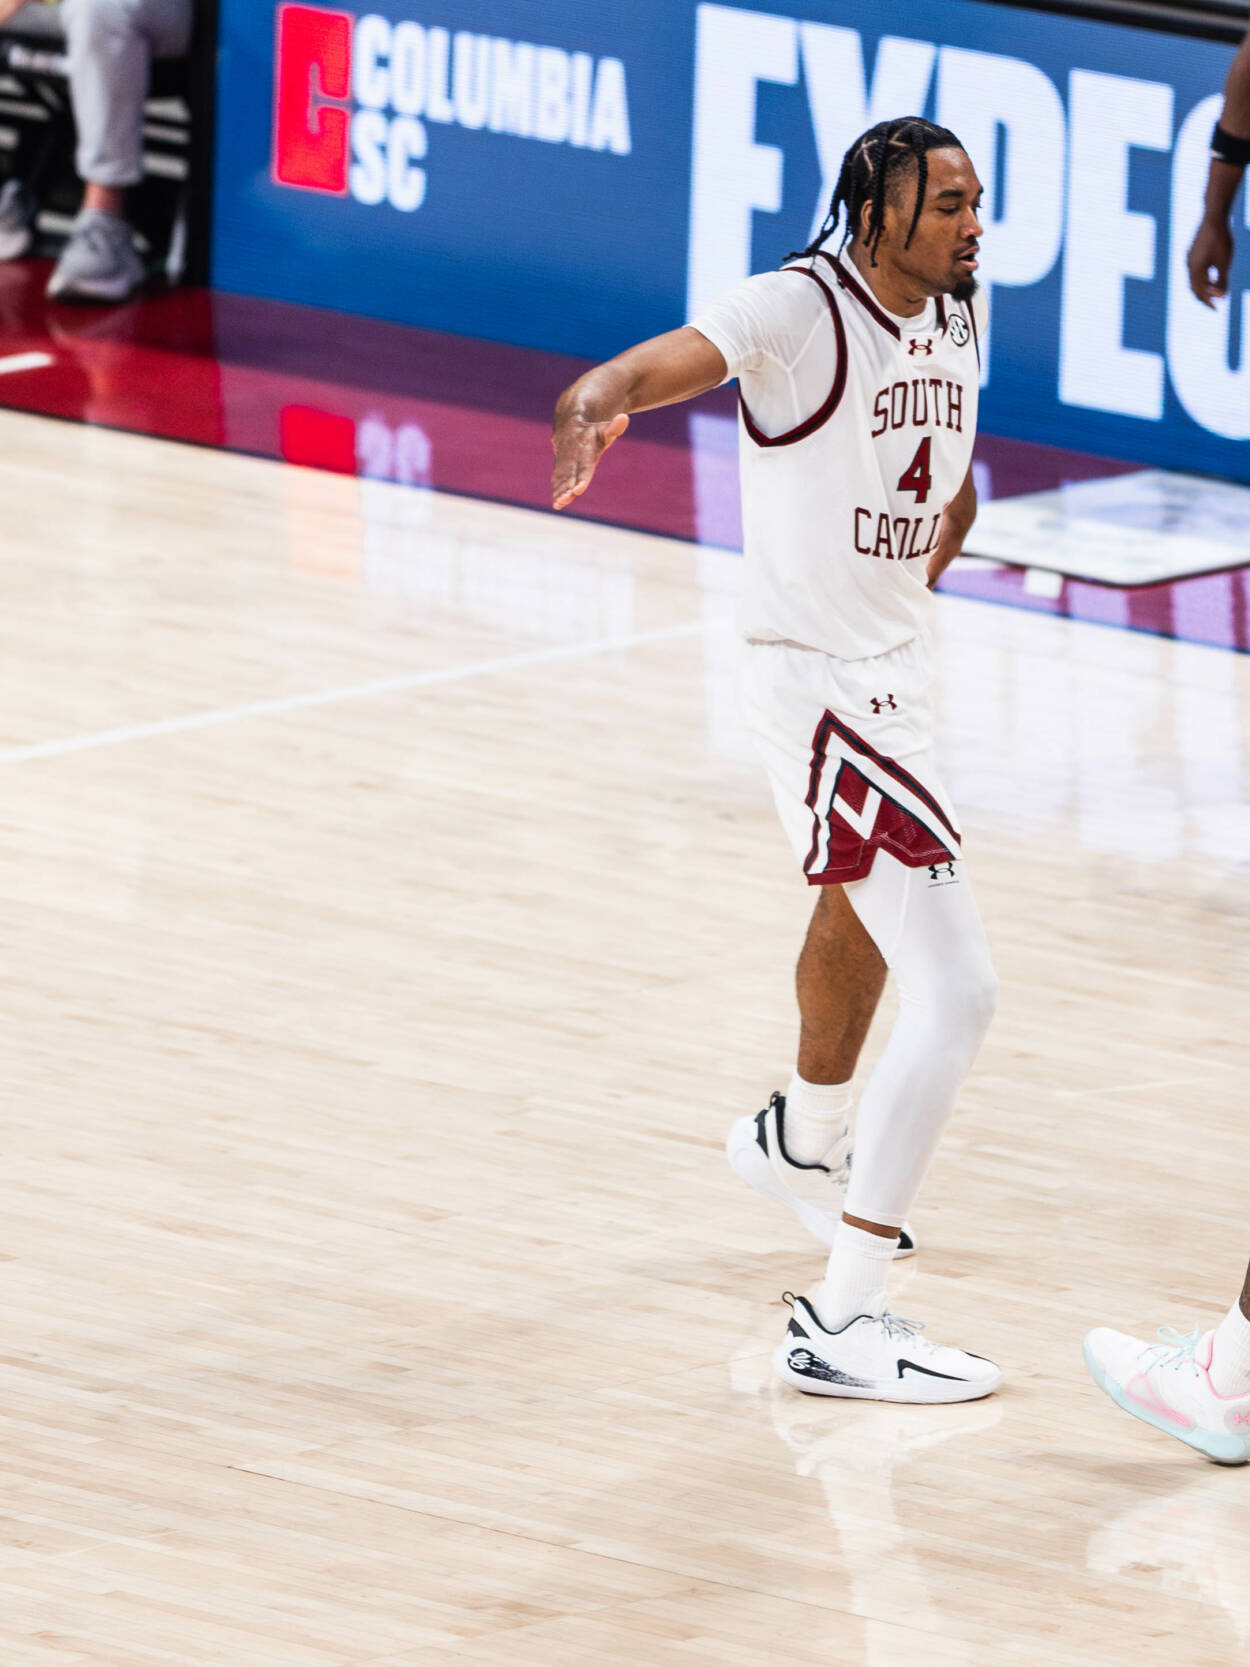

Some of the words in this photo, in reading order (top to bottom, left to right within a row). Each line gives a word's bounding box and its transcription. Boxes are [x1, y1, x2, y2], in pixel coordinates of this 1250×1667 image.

[352, 13, 632, 157] COLUMBIA
[349, 108, 429, 214] SC
[871, 378, 963, 438] SOUTH
[896, 435, 932, 504] 4
